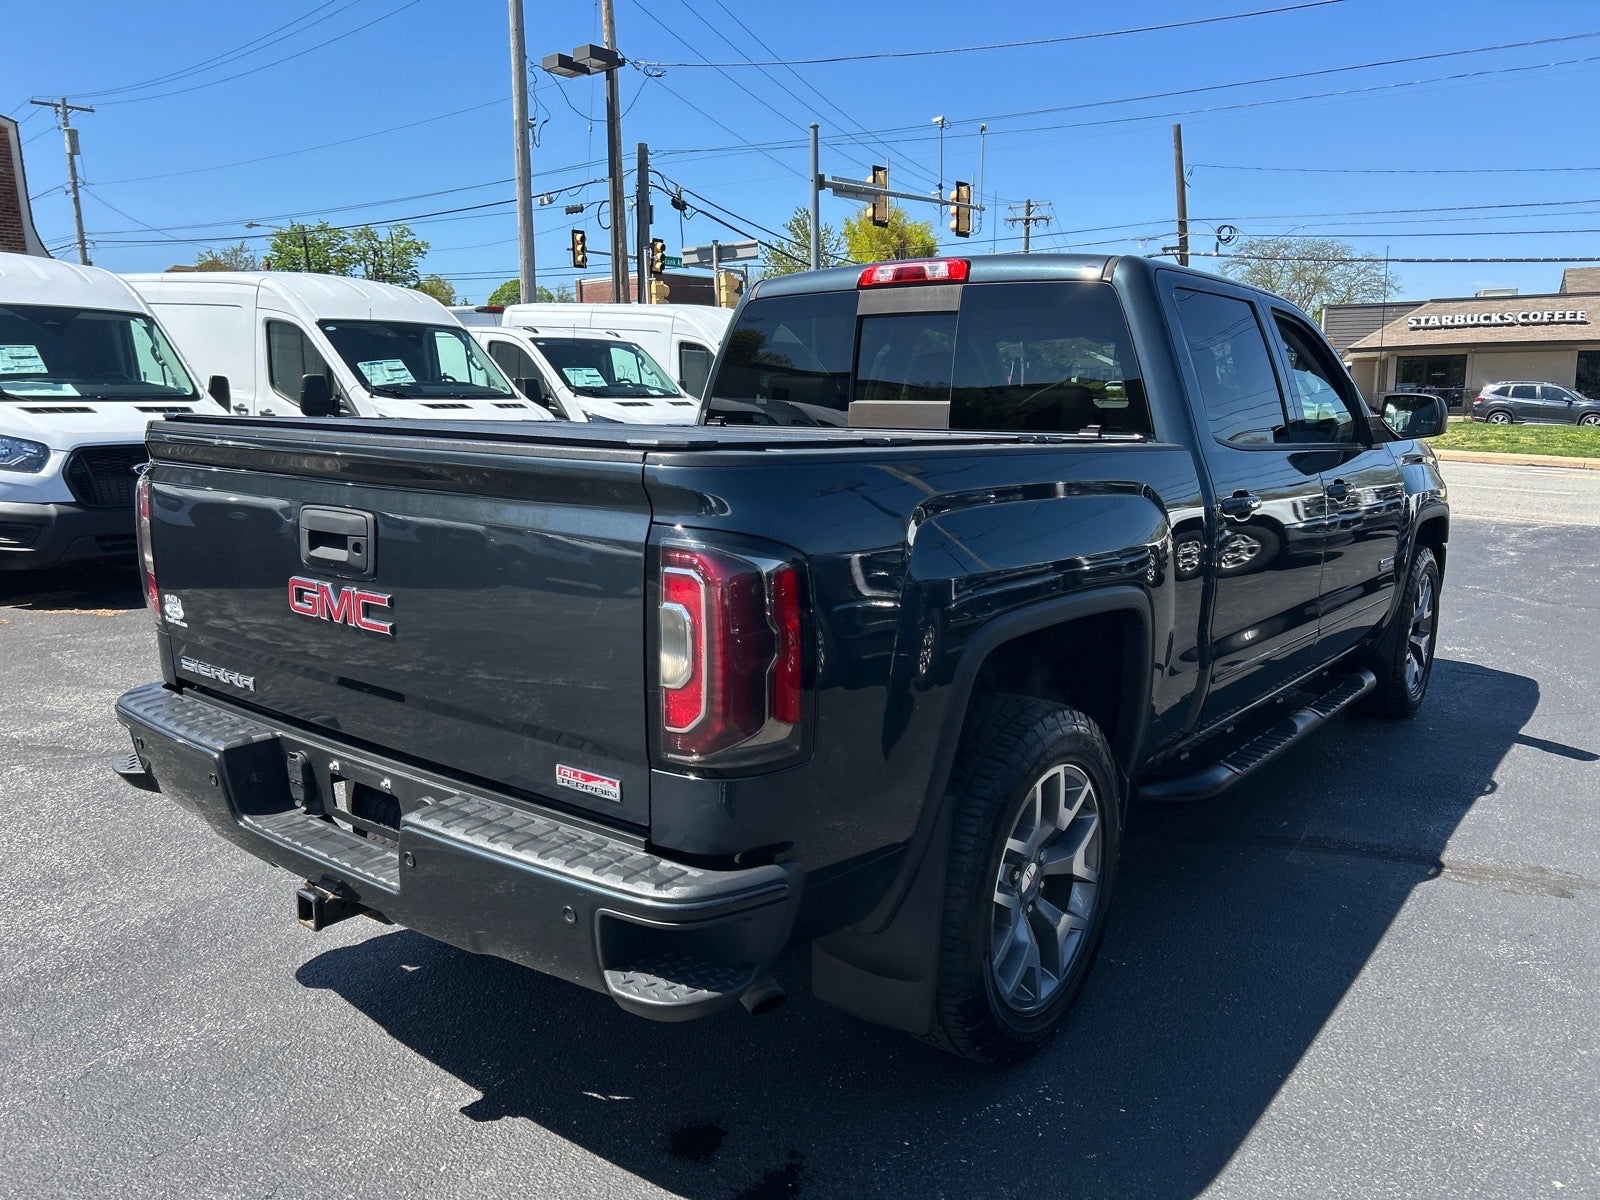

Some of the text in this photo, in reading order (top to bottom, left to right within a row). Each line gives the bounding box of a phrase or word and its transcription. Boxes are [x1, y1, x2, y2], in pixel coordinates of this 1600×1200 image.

[1407, 310, 1587, 328] STARBUCKS COFFEE
[288, 576, 392, 636] GMC
[181, 655, 256, 692] SIERRA
[561, 768, 586, 782] ALL
[560, 778, 617, 798] TERRAIN
